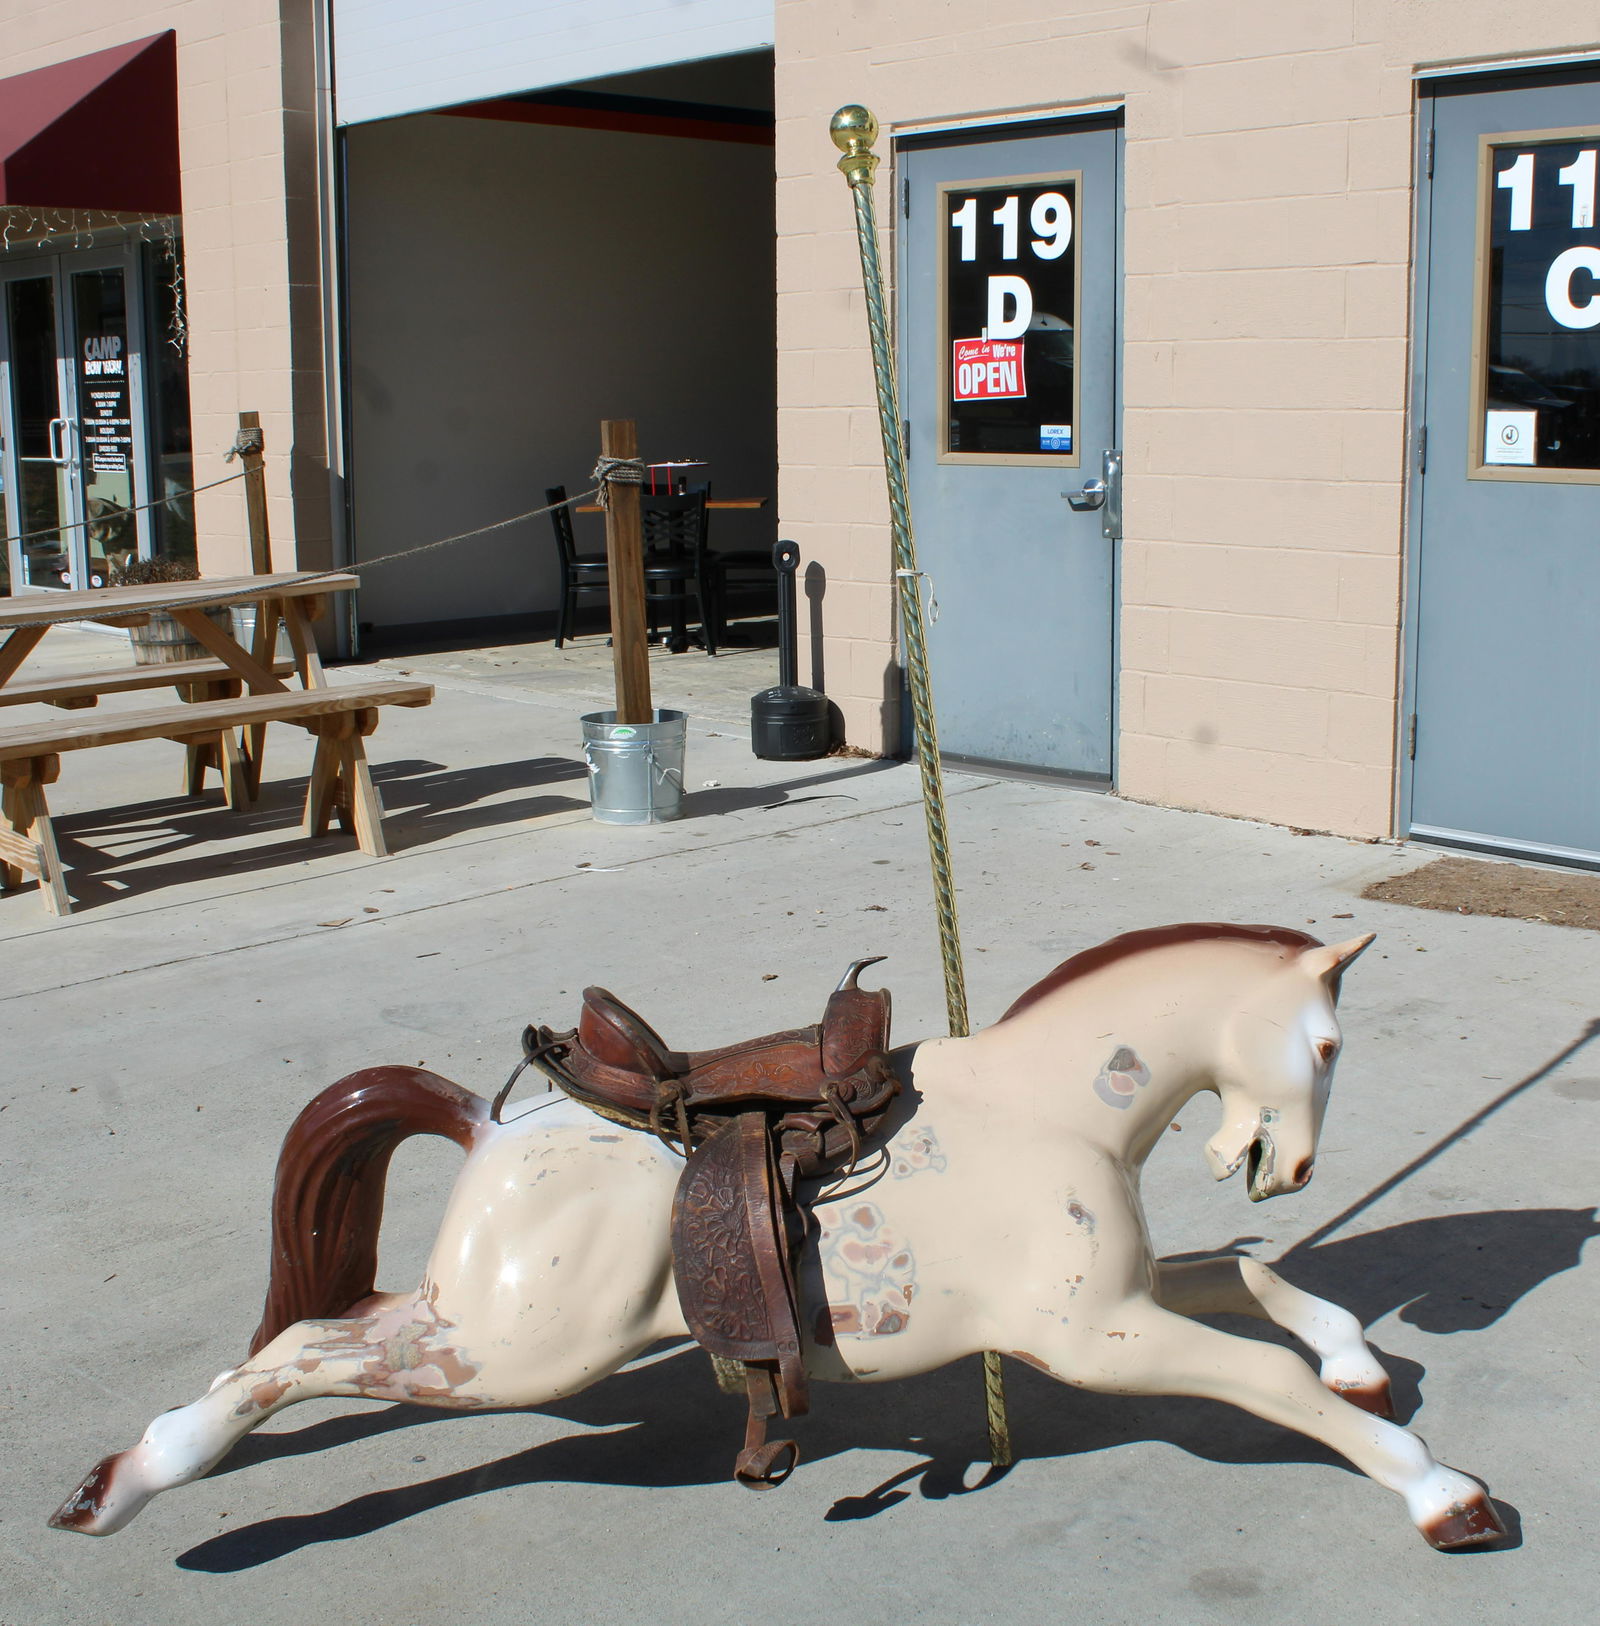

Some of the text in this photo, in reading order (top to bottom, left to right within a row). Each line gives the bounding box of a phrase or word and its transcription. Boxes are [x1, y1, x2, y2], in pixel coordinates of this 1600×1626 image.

[951, 192, 1072, 262] 119
[987, 275, 1033, 340] D
[1545, 246, 1600, 329] C
[84, 336, 121, 360] CAMP
[958, 344, 1016, 360] Come in We're
[958, 361, 1018, 395] OPEN
